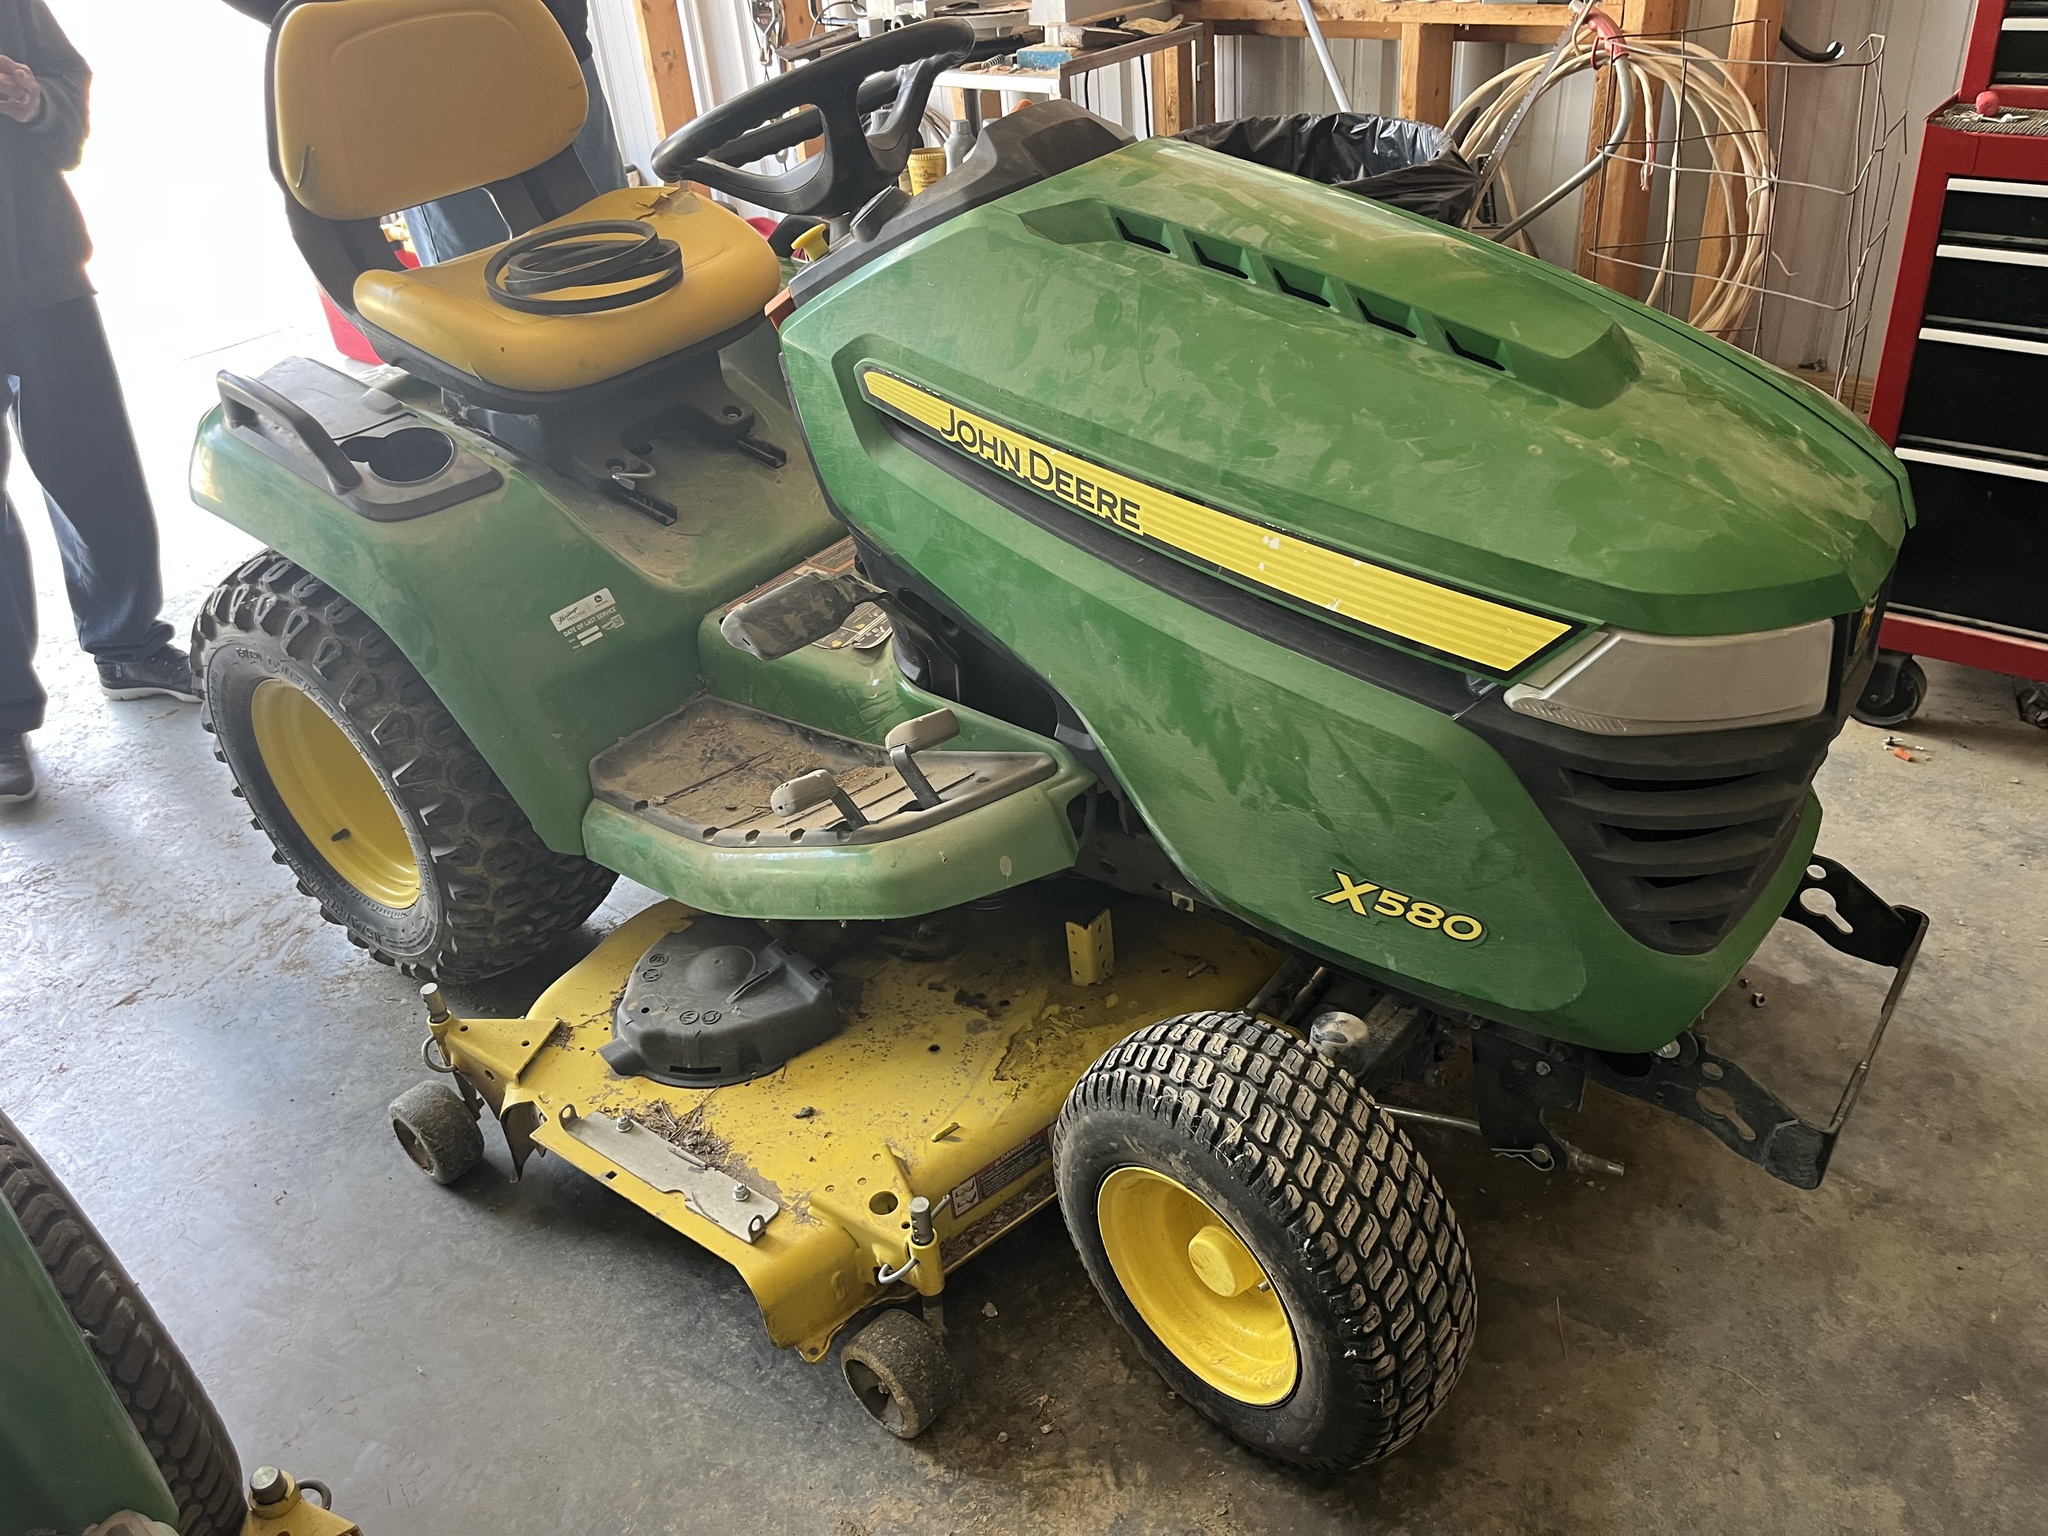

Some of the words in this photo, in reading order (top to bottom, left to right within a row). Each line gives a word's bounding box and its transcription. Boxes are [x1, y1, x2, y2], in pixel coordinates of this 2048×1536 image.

[940, 408, 1021, 473] JOHN
[1029, 448, 1141, 531] DEERE
[563, 627, 577, 637] DATE
[576, 622, 584, 630] OF
[584, 616, 596, 626] LAST
[597, 606, 616, 618] SERVICE
[1321, 872, 1483, 941] X580
[1001, 1139, 1031, 1160] DANGER
